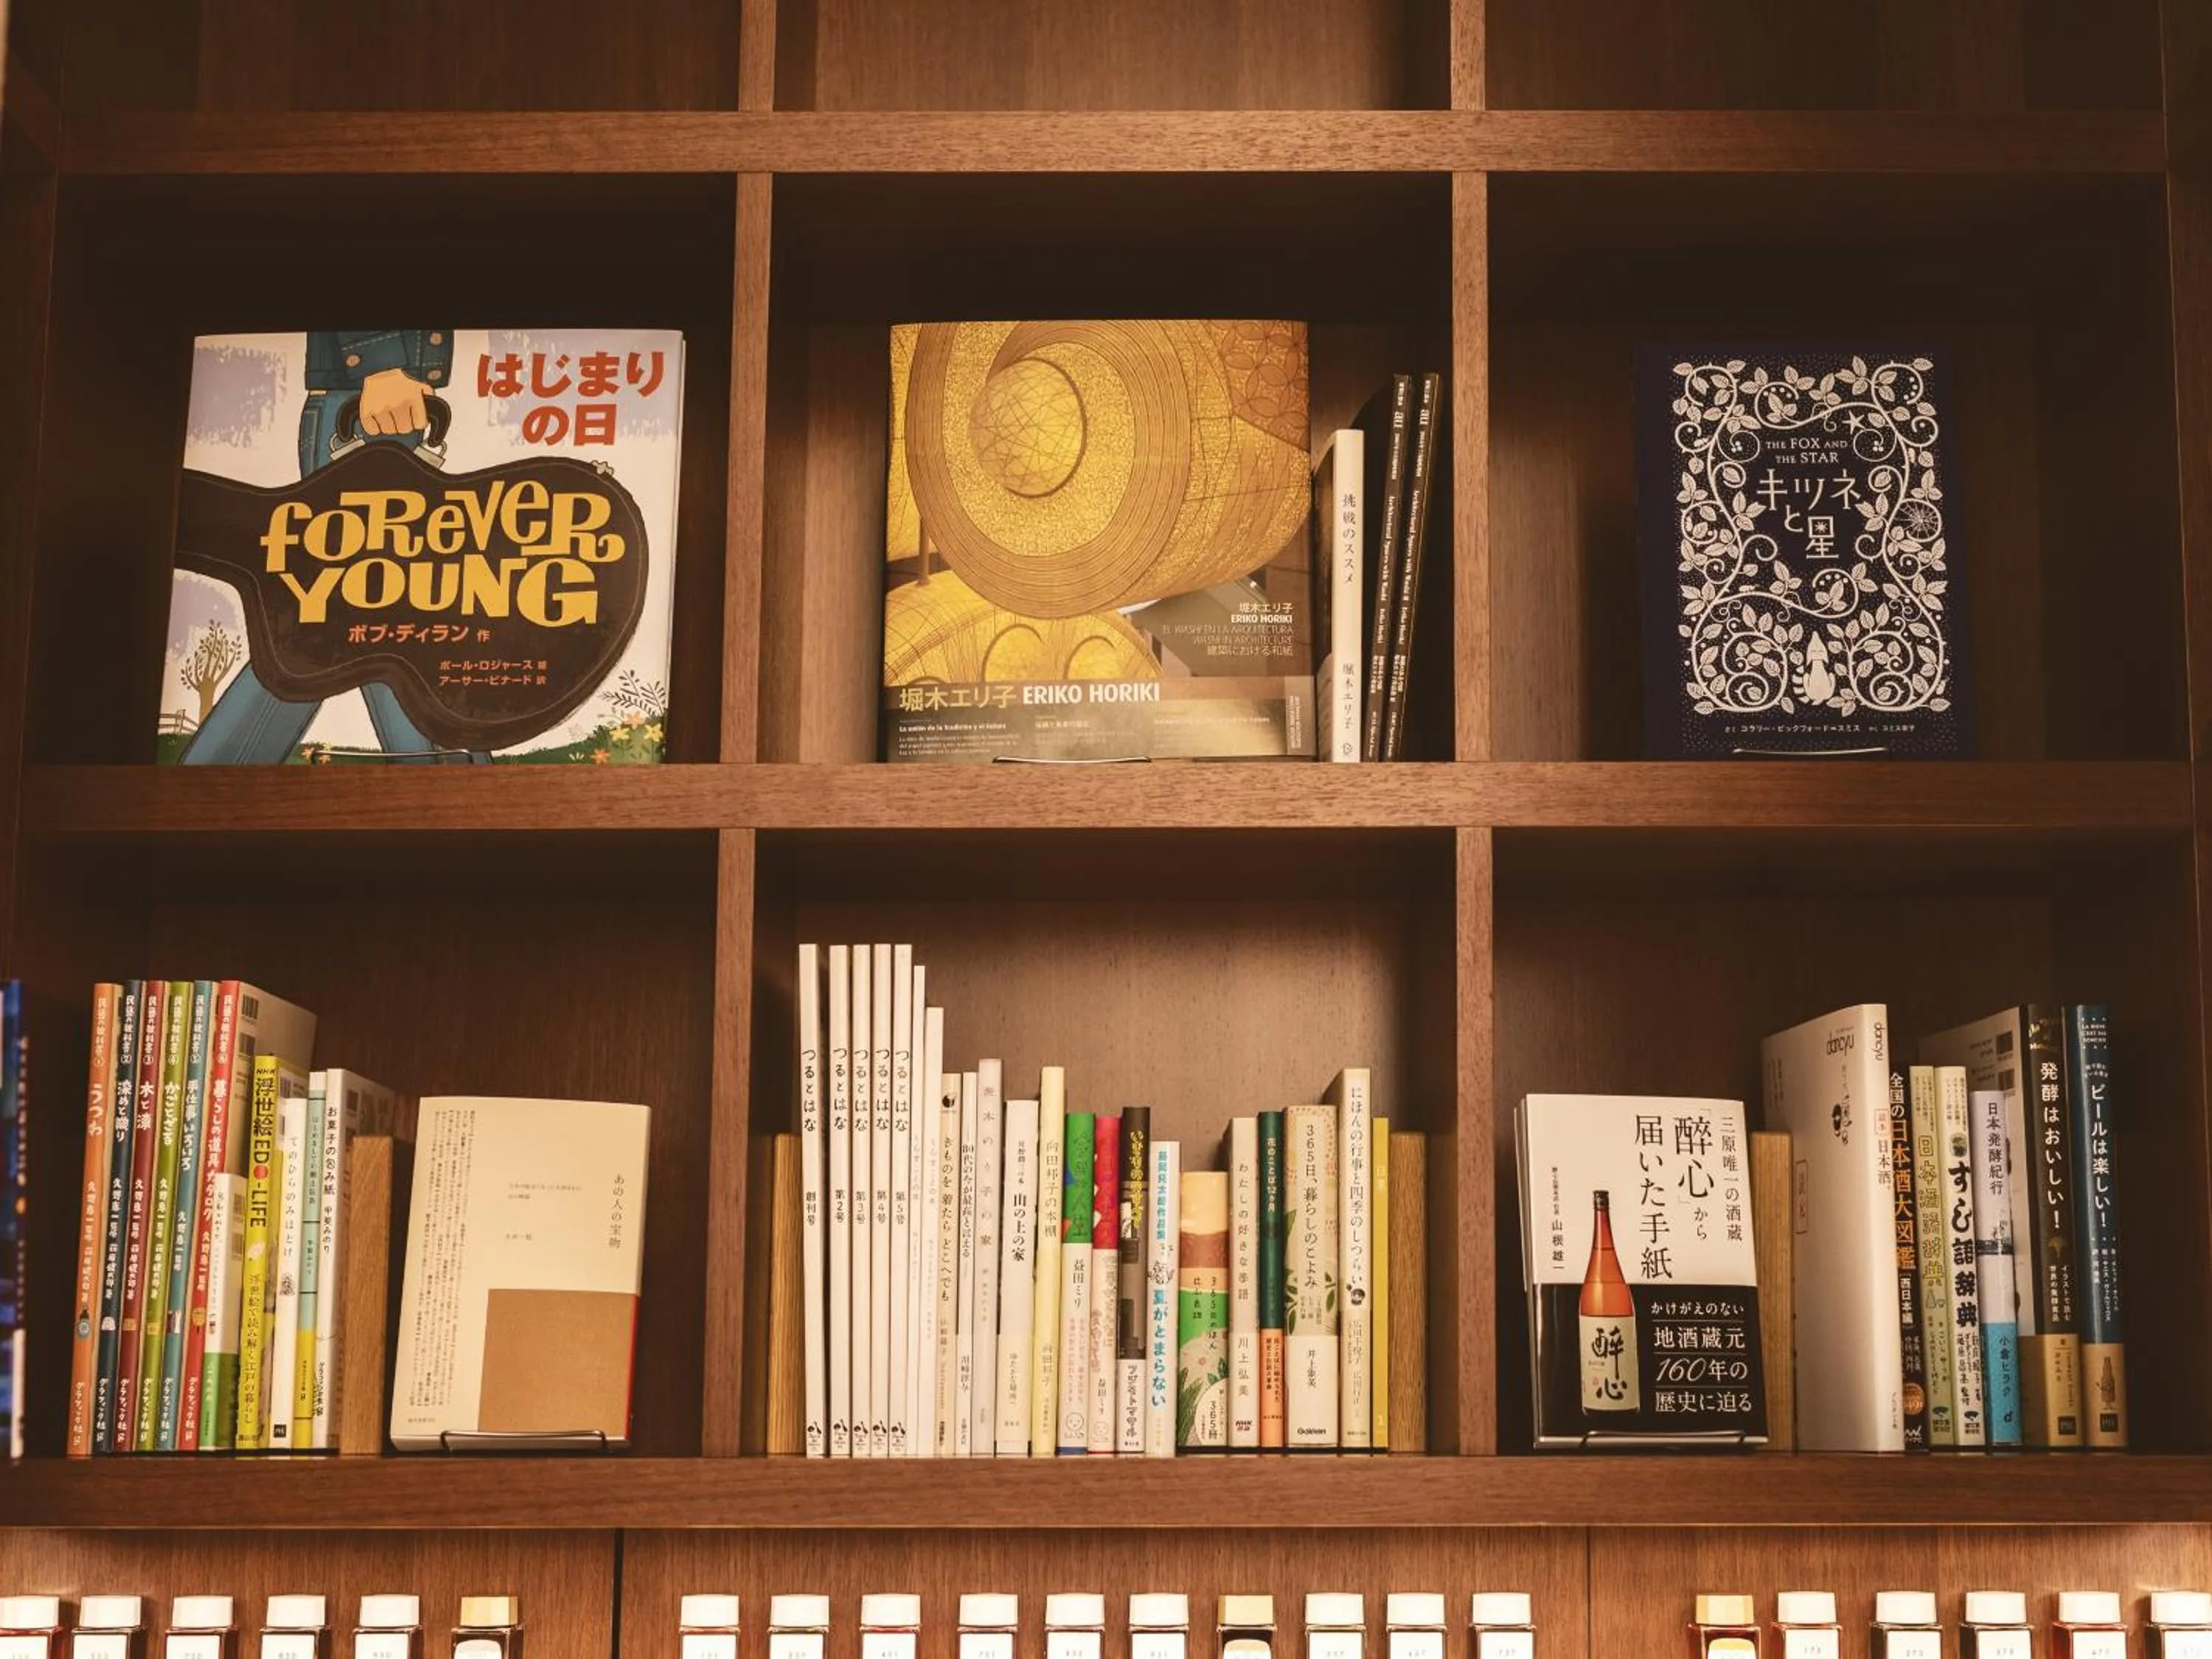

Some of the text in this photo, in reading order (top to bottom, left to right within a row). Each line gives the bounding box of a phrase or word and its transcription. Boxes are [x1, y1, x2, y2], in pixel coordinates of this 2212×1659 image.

[476, 351, 666, 400] はじまり
[522, 403, 617, 447] の日
[1765, 438, 1848, 450] THE FOX AND
[1775, 451, 1839, 464] THE STAR
[1756, 468, 1861, 511] キツネ
[1342, 493, 1357, 584] 挑戦のススメ
[1784, 505, 1840, 559] と星
[279, 554, 599, 627] YOUNG
[1231, 614, 1293, 624] ERIKO HORIKI
[1239, 602, 1293, 614] 堀木エリ子
[348, 624, 491, 643] ボブ・ディラン 作
[899, 685, 1017, 712] 堀木エリ子
[1023, 682, 1160, 705] ERIKO HORIKI
[1342, 664, 1355, 729] 堀木エリ子
[1871, 1022, 1885, 1061] dancyu
[87, 1083, 104, 1137] うつわ
[114, 1080, 133, 1142] 染めと織り
[136, 1080, 155, 1131] 木と漆
[162, 1081, 181, 1147] かごとざる
[253, 1077, 276, 1138] 浮世絵
[854, 1049, 869, 1132] つるとはな
[875, 1048, 890, 1131] つるとはな
[895, 1050, 910, 1132] つるとはな
[181, 1079, 199, 1172] 手仕事いろいろ
[324, 1106, 337, 1195] お菓子の包み紙
[801, 1049, 816, 1225] つるとはな 創刊号
[833, 1048, 847, 1223] つるとはな 第2号
[1986, 1102, 2004, 1196] 日本発酵紀行
[2040, 1061, 2064, 1229] 発酵はおいしい！
[2091, 1083, 2111, 1229] ビールは楽しい！
[283, 1136, 298, 1258] てのひらのみほとけ
[1045, 1141, 1059, 1238] 向田邦子の本棚
[1350, 1088, 1364, 1284] にほんの行事と四季のしつらい
[1634, 1114, 1673, 1280] 届いた手紙
[1720, 1116, 1743, 1243] 三原唯一の酒蔵
[1888, 1073, 1916, 1270] 全国の日本酒大図鑑
[608, 1173, 625, 1249] あの人の宝物
[941, 1136, 954, 1302] きものを着たらどこへでも
[1012, 1193, 1027, 1262] 山の上の家
[1238, 1164, 1249, 1301] わたしの好きな季語
[1304, 1124, 1319, 1289] 365日、暮らしのこよみ
[1073, 1259, 1085, 1310] 益田ミリ
[1650, 1301, 1746, 1315] かけがえのない
[1152, 1289, 1168, 1407] 夏がとまらない
[1238, 1338, 1250, 1397] 川上弘美
[1654, 1326, 1746, 1349] 地酒蔵元
[1655, 1358, 1748, 1382] 160年の
[1999, 1336, 2011, 1398] 小倉ヒラク
[1127, 1365, 1138, 1438] フジモトマサル
[1655, 1391, 1752, 1413] 歴史に迫る
